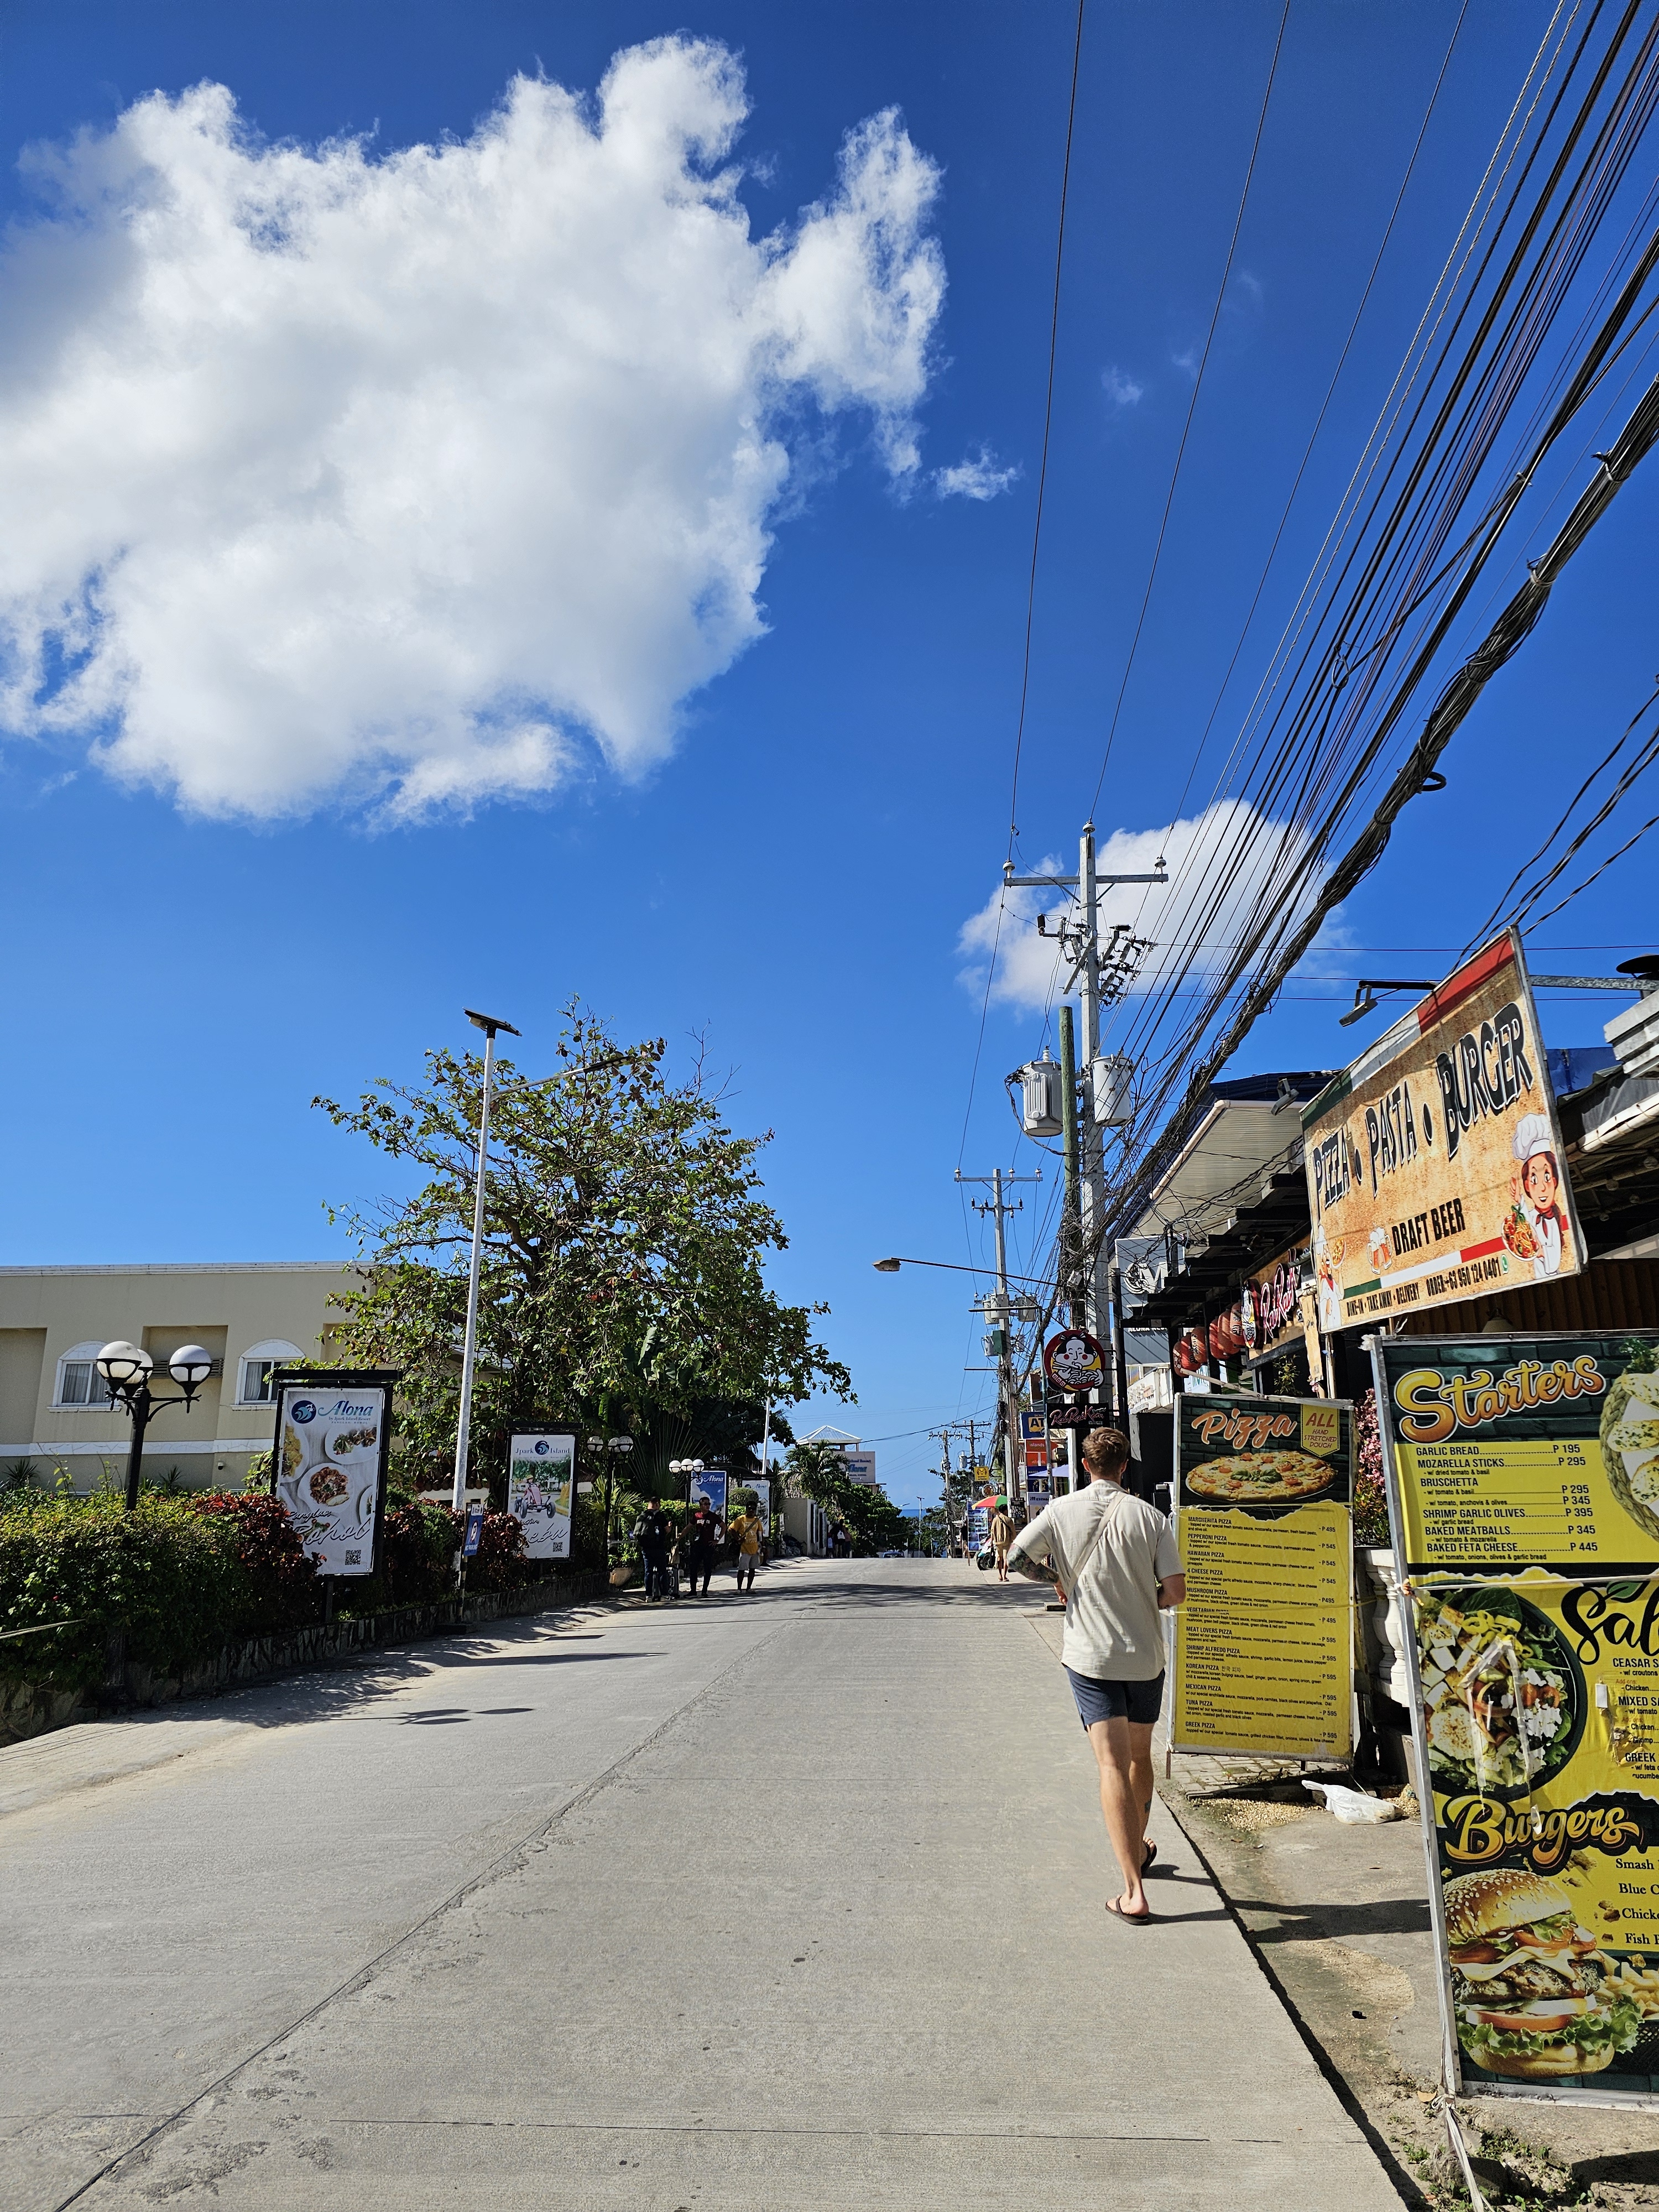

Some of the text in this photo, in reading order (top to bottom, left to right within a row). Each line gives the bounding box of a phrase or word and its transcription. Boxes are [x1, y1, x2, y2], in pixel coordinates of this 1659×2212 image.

[1313, 1001, 1534, 1224] PIZZA PASTA BURGER
[1391, 1198, 1465, 1256] DRAFT BEER
[1347, 1298, 1364, 1317] DINE-IN
[1366, 1294, 1379, 1312] TAKE
[1379, 1290, 1392, 1309] AWAY
[1396, 1282, 1420, 1305] DELIVERY
[1458, 1266, 1471, 1287] 950
[1471, 1262, 1484, 1283] 124
[1483, 1257, 1501, 1280] 0401
[1394, 1355, 1606, 1444] Starters
[318, 1400, 373, 1416] Alona
[1030, 1418, 1045, 1427] AT
[1306, 1412, 1334, 1428] ALL
[1191, 1408, 1298, 1449] Pizza
[1416, 1447, 1447, 1455] GARLIC
[1562, 1444, 1580, 1453] 195
[1418, 1459, 1470, 1468] MOZARELLA
[1567, 1457, 1586, 1465] 295
[1421, 1478, 1479, 1486] BRUSCHETTA
[1570, 1485, 1589, 1494] 295
[1572, 1496, 1590, 1504] 345
[1423, 1509, 1457, 1518] SHRIMP
[1460, 1509, 1491, 1517] GARLIC
[1574, 1508, 1593, 1517] 395
[1425, 1526, 1454, 1535] BAKED
[1577, 1525, 1595, 1534] 345
[1427, 1543, 1456, 1552] BAKED
[1459, 1543, 1481, 1552] FETA
[1579, 1542, 1598, 1551] 445
[1613, 1658, 1650, 1667] CEASAR
[1618, 1696, 1648, 1706] MIXED
[1625, 1752, 1656, 1762] GREEK
[1444, 1794, 1640, 1865] Burgers
[1616, 1858, 1655, 1870] Smash
[1619, 1883, 1646, 1895] Blue
[1625, 1933, 1651, 1944] Fish
